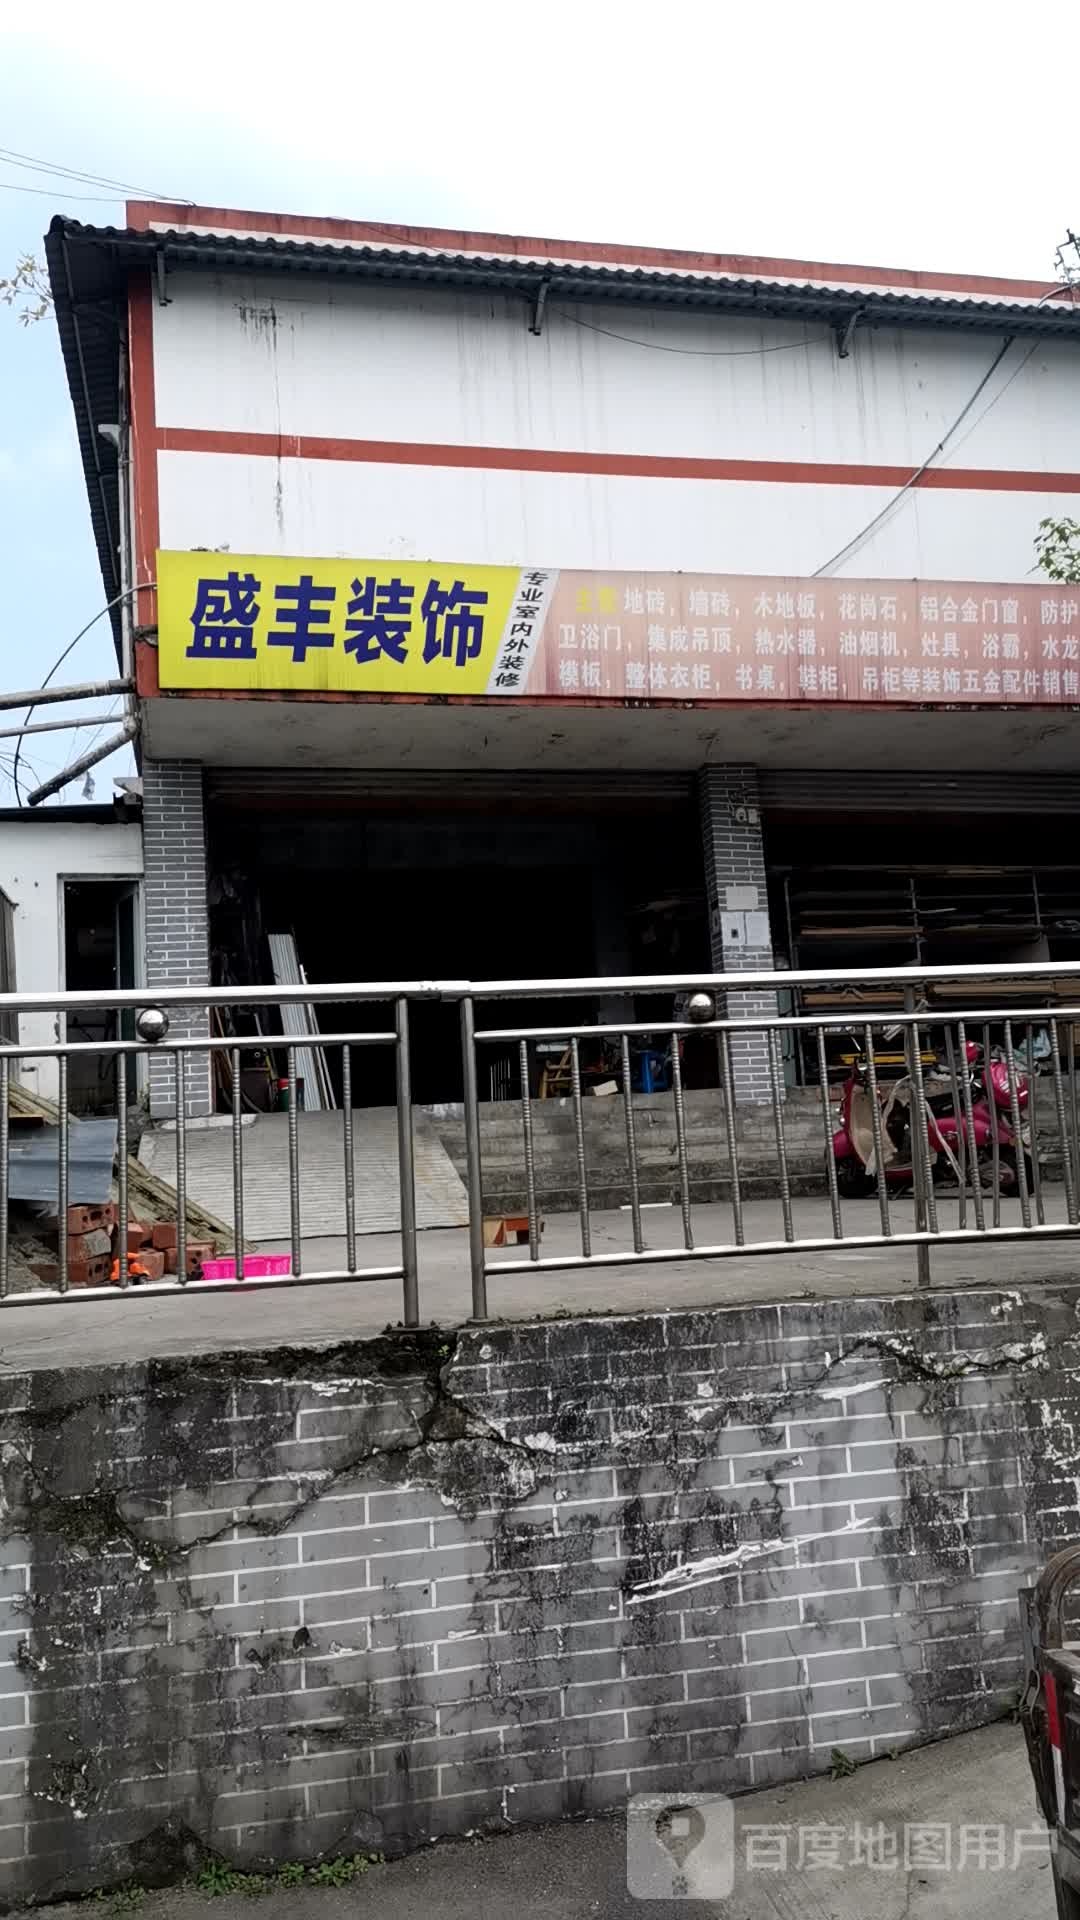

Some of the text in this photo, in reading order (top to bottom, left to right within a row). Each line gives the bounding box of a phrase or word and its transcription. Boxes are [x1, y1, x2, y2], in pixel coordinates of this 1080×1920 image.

[185, 572, 489, 666] 盛丰装饰
[495, 572, 548, 687] 专业室内外装修
